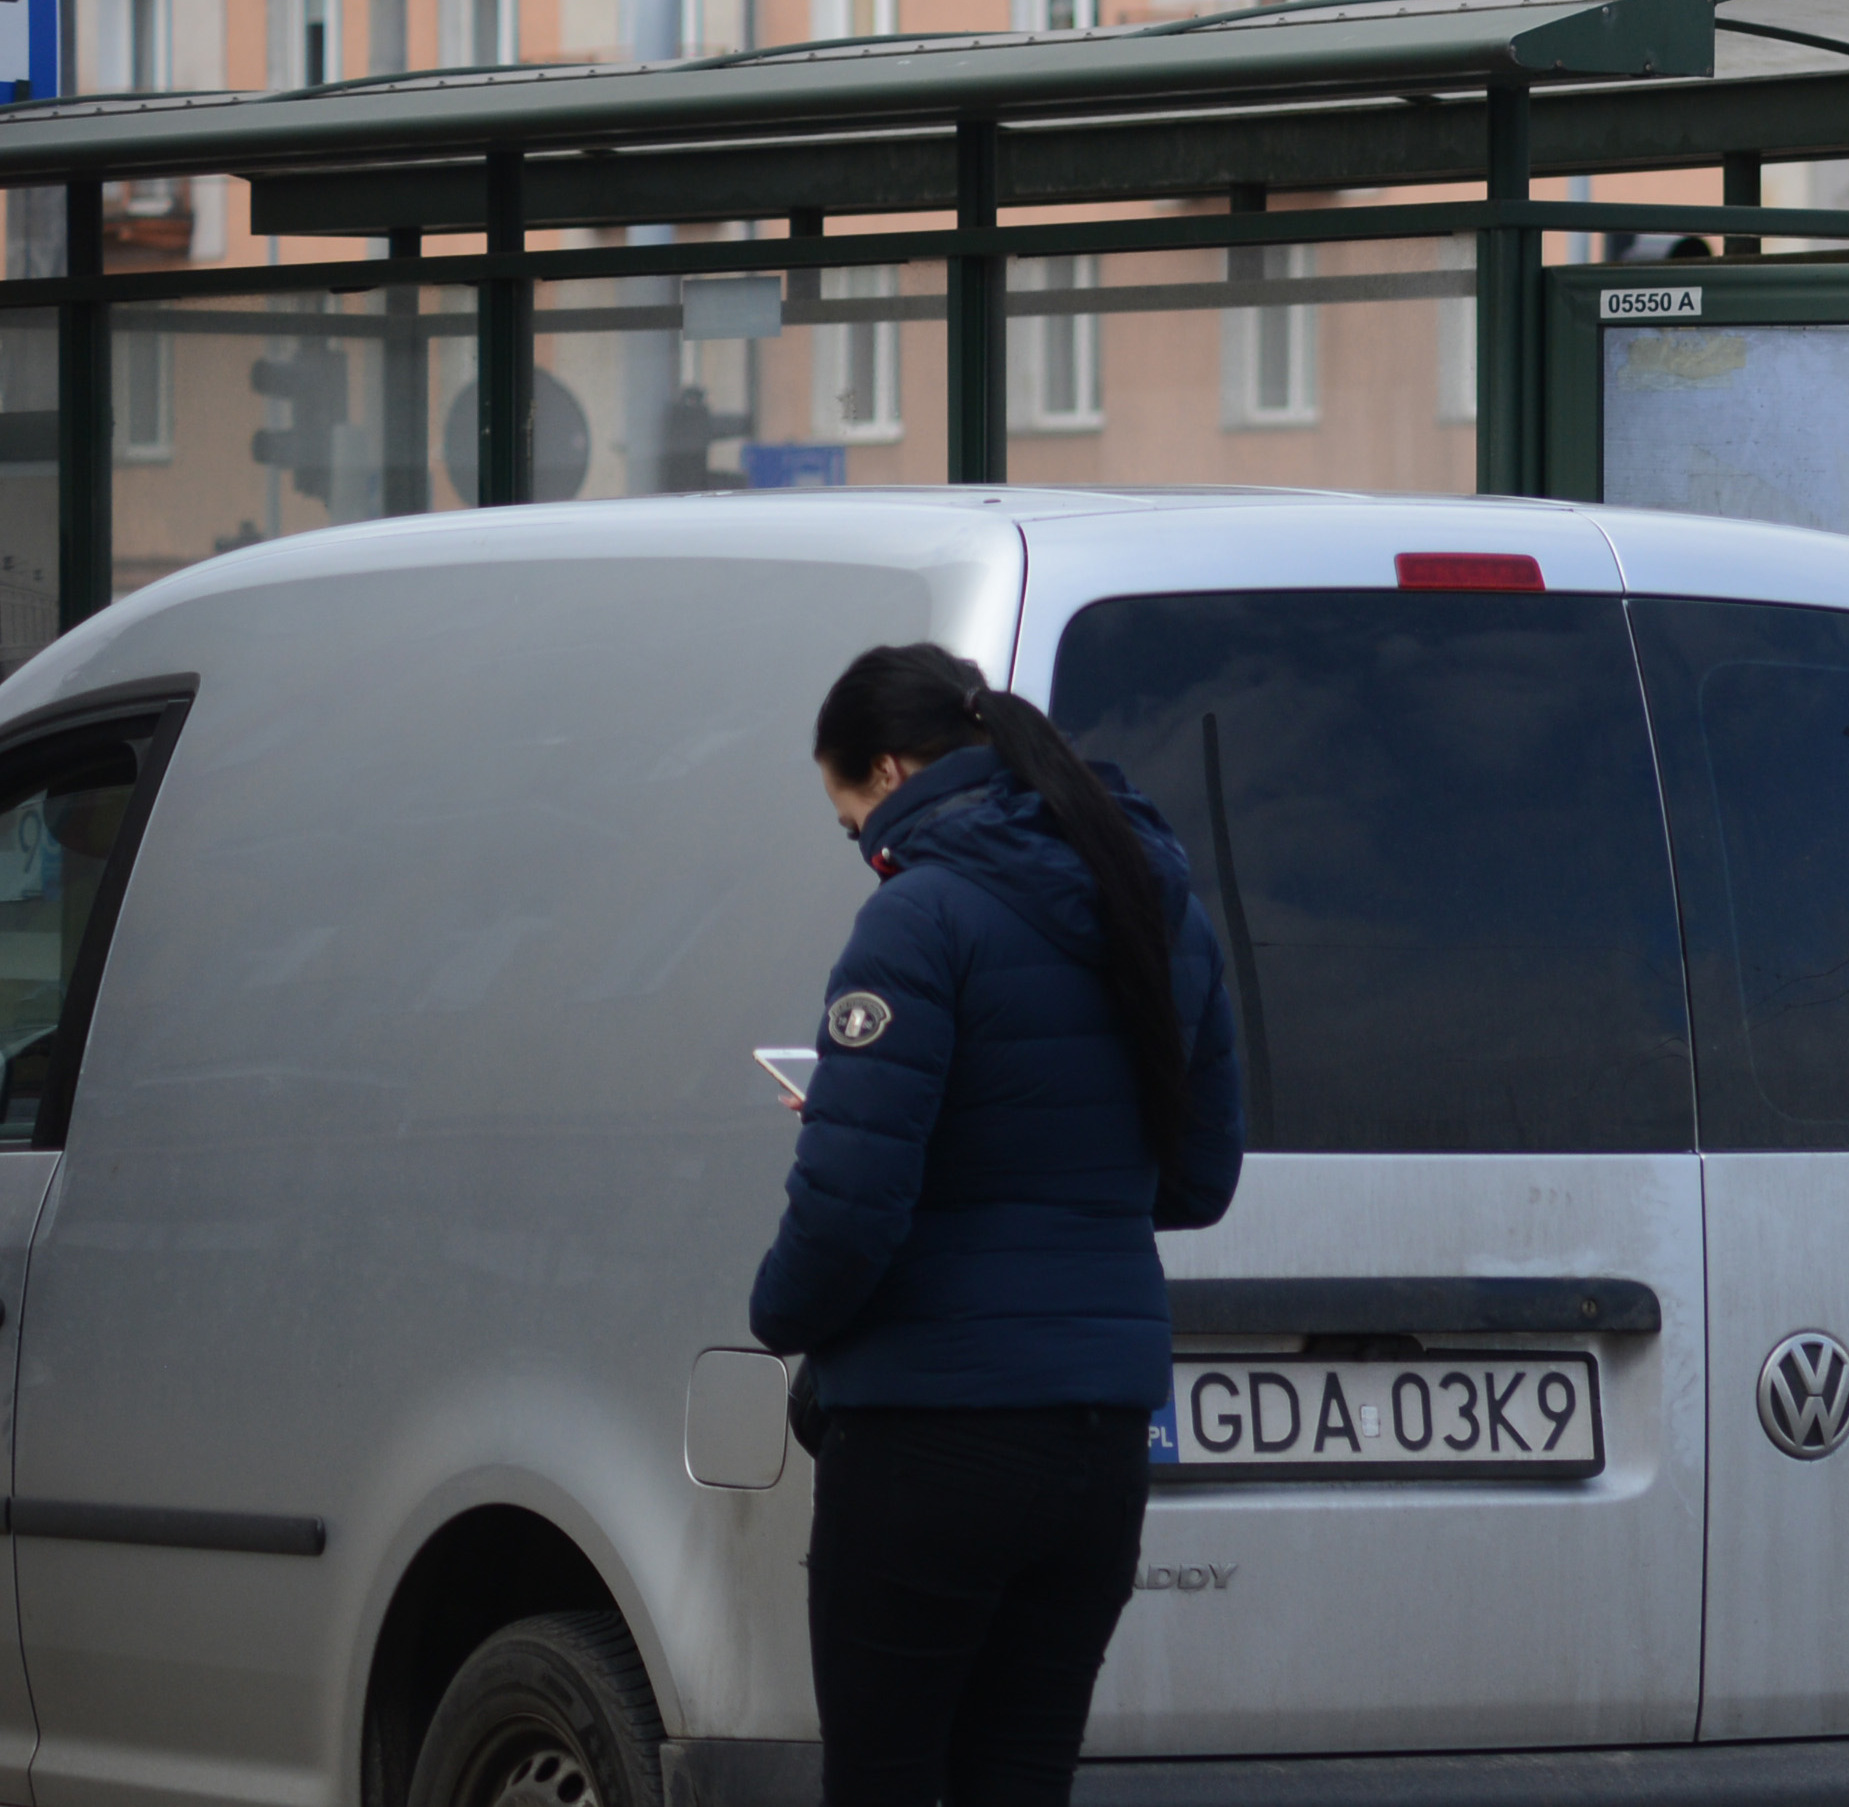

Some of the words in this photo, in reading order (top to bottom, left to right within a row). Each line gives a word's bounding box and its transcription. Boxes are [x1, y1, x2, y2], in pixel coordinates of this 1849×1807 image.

[1608, 292, 1672, 314] 05550
[1678, 291, 1694, 312] A
[1190, 1371, 1361, 1453] GDA
[1392, 1371, 1577, 1452] 03K9
[1148, 1426, 1173, 1447] PL
